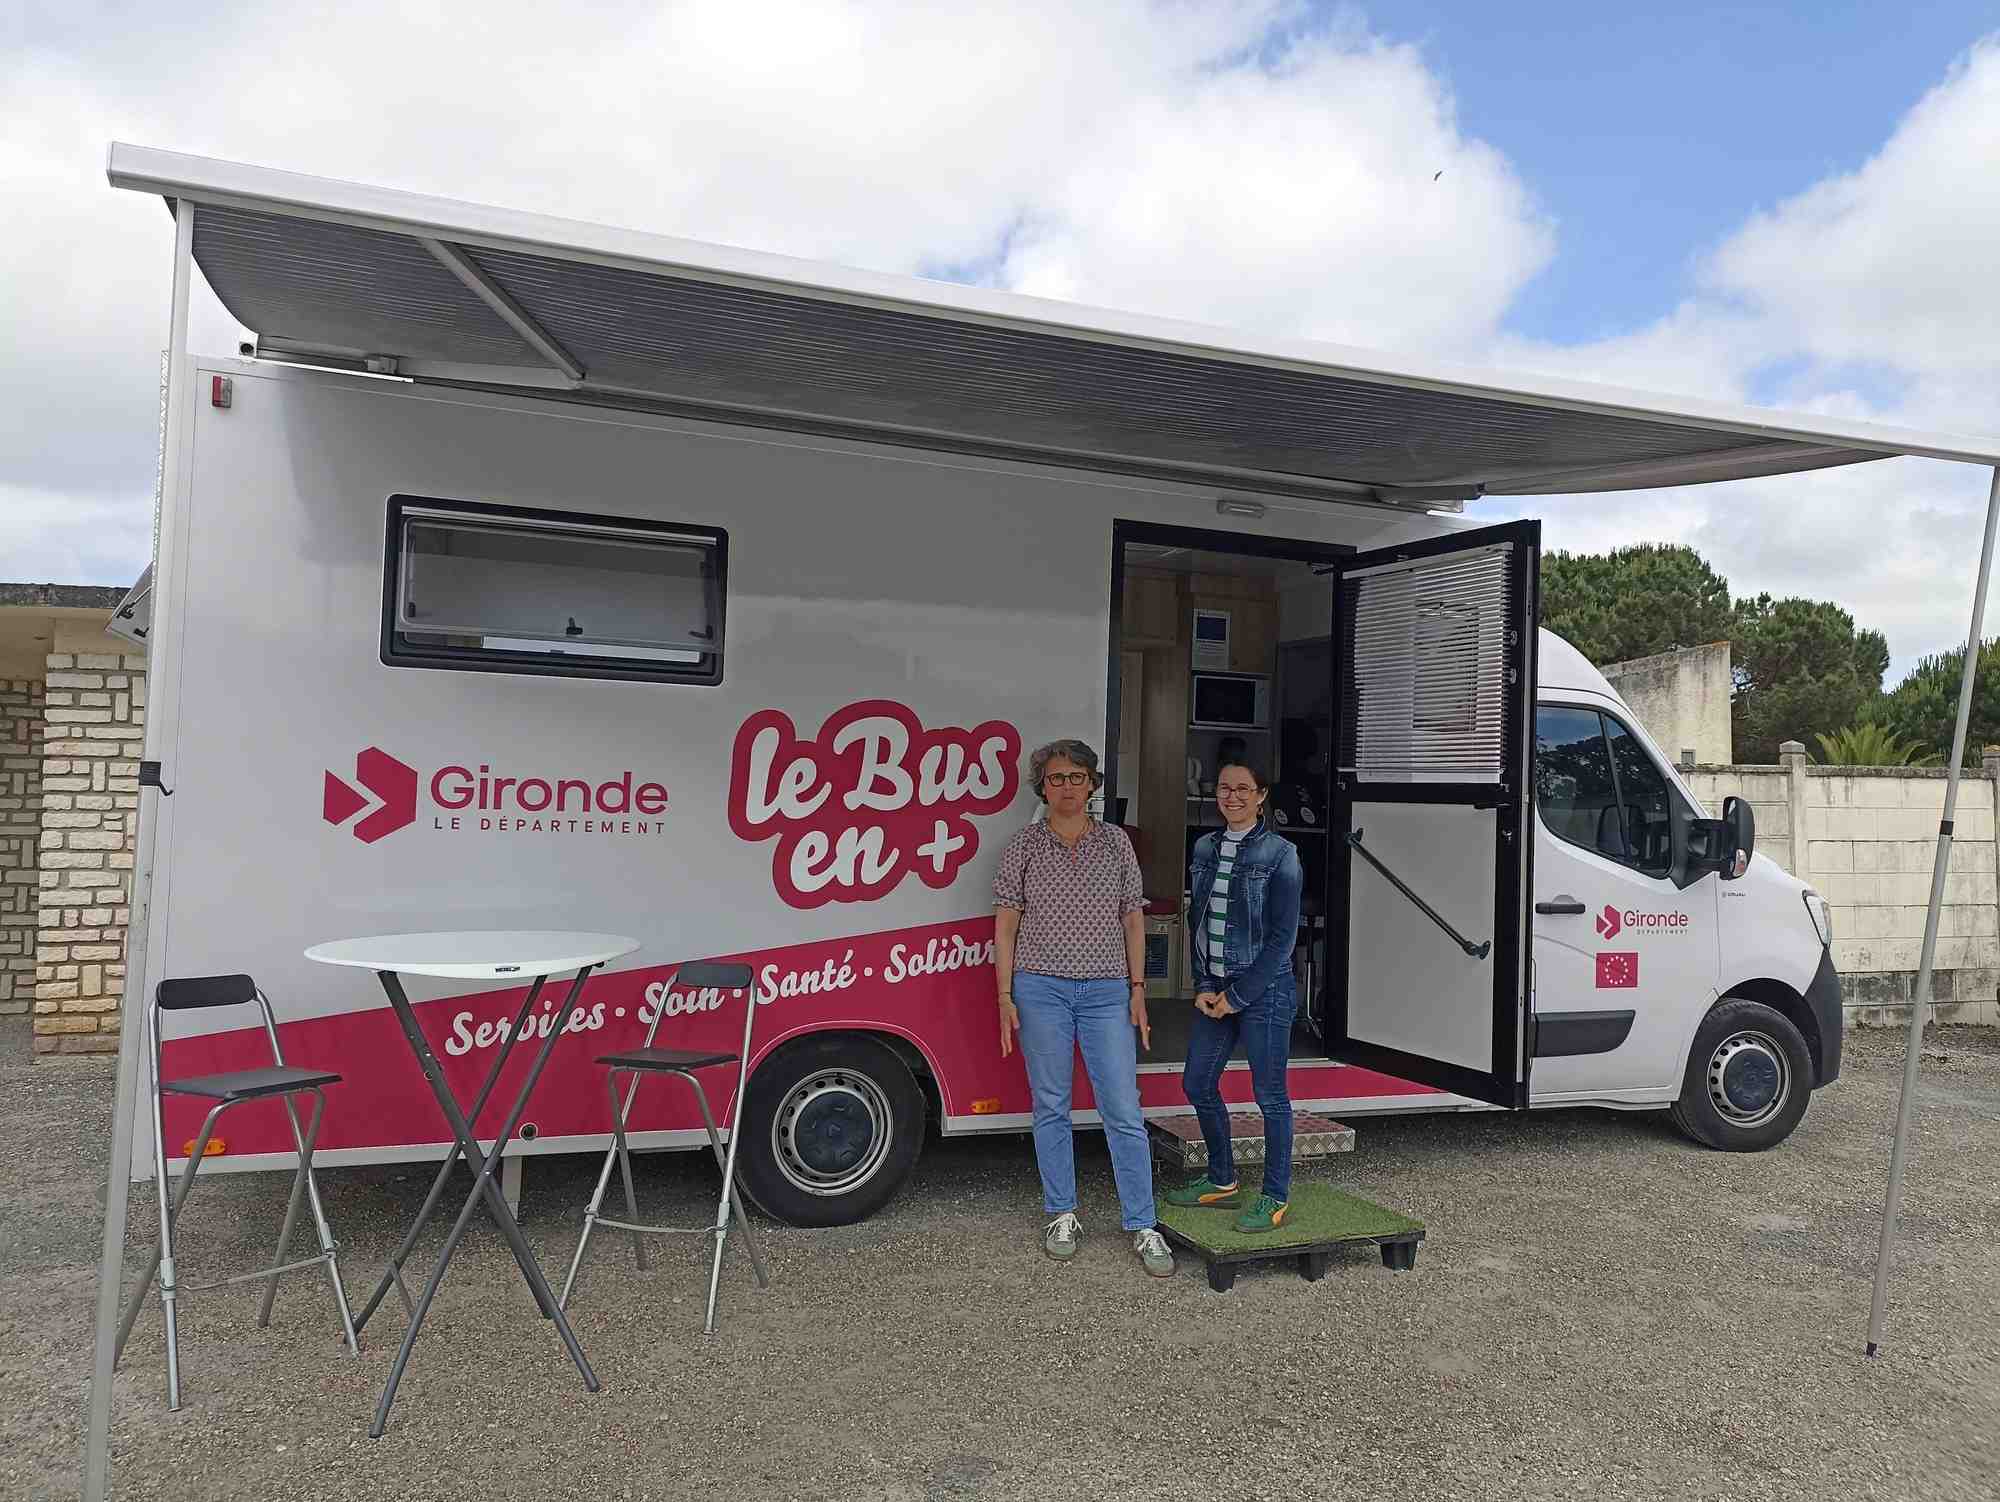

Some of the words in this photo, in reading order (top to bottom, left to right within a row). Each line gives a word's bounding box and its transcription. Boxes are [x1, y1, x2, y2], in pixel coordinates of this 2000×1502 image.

[430, 764, 669, 815] Gironde
[746, 726, 832, 825] le
[833, 715, 1008, 811] Bus
[433, 816, 461, 830] LE
[480, 816, 665, 834] DÉPARTEMENT
[790, 825, 900, 893] en
[917, 819, 966, 873] +
[1623, 910, 1688, 927] Gironde
[445, 1000, 606, 1056] Servies
[756, 949, 857, 1005] Santé
[884, 934, 1000, 984] Solidar
